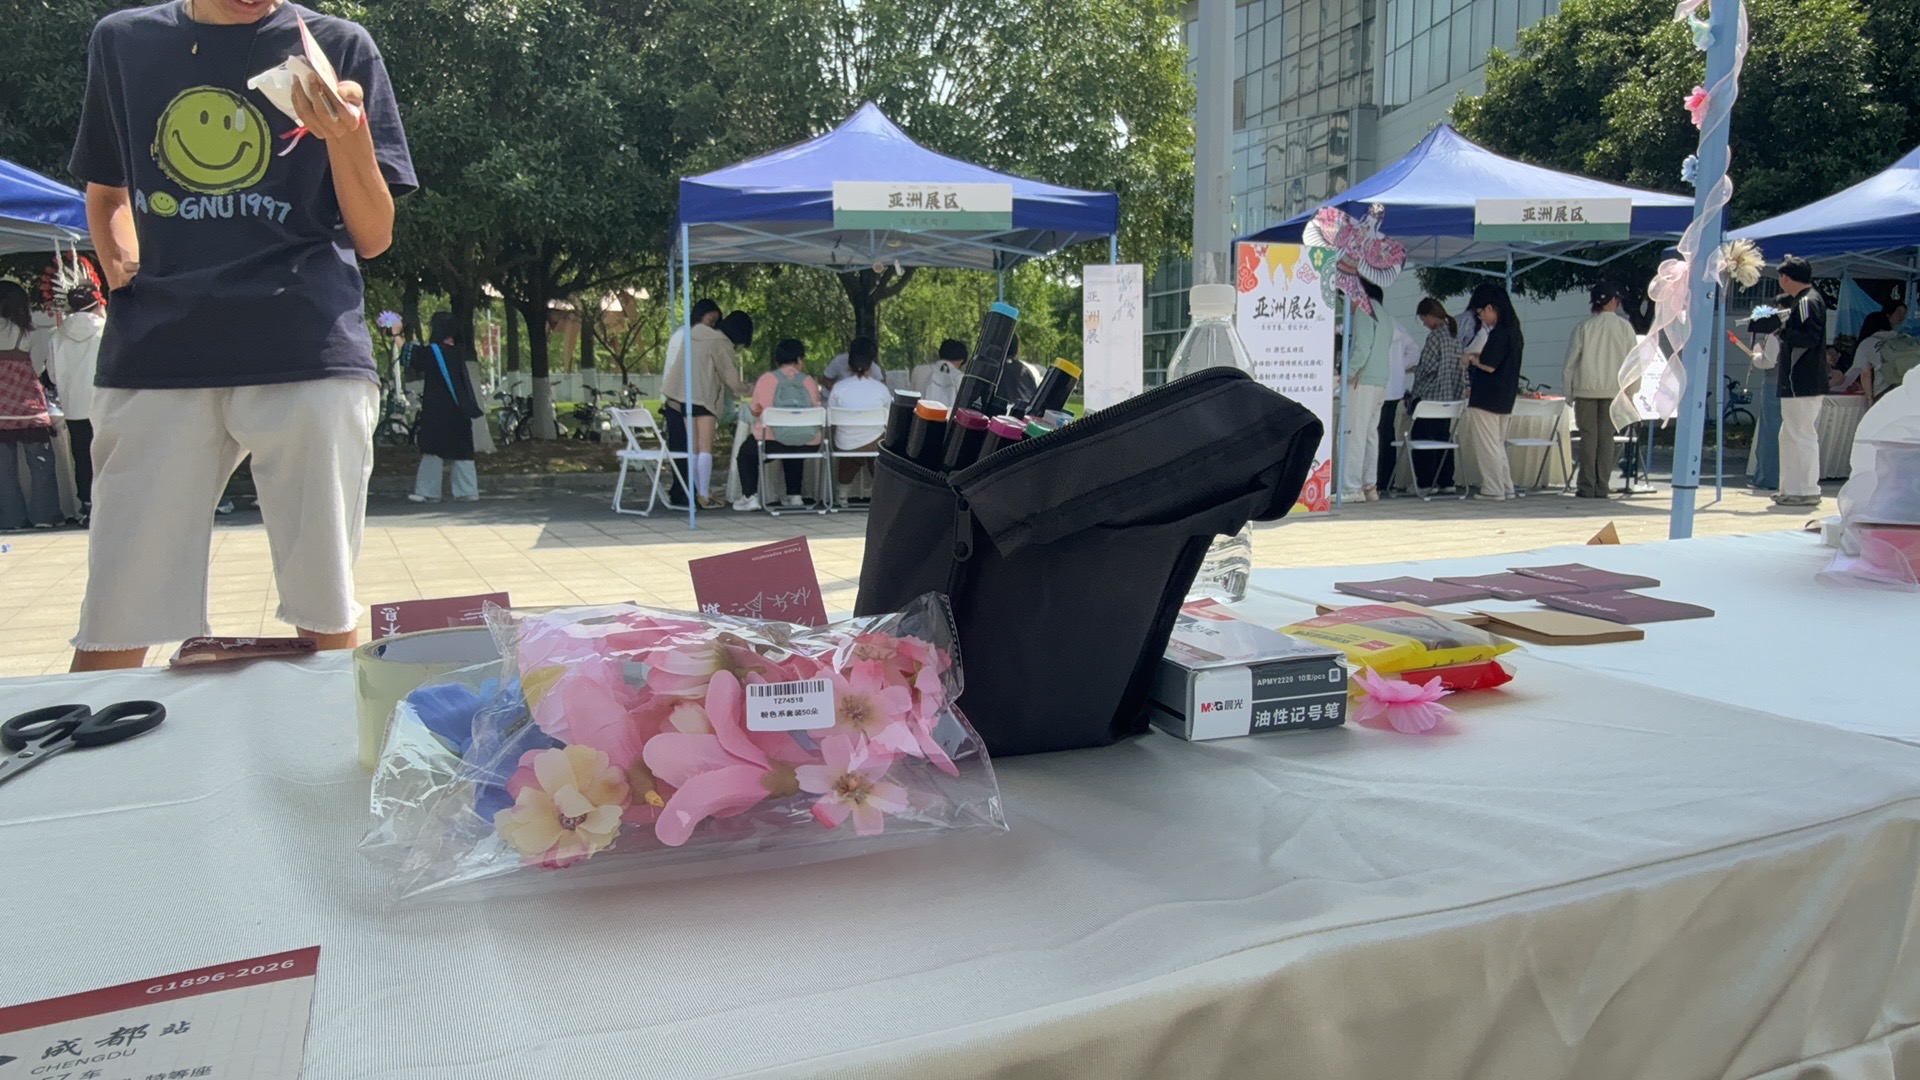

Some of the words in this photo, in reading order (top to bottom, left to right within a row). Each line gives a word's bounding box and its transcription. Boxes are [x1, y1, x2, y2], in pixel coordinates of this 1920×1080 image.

[240, 192, 292, 224] 1997
[888, 191, 960, 210] 亚洲展区
[1521, 205, 1584, 223] 亚洲展区
[1085, 291, 1101, 344] 亚洲展
[1252, 295, 1317, 320] 亚洲展台
[1256, 676, 1294, 686] APMY2220
[760, 708, 819, 719] 粉色系套装50朵
[1254, 702, 1340, 727] 油性记号笔
[145, 959, 296, 995] G1896-2026
[30, 1048, 137, 1075] CHENGDU
